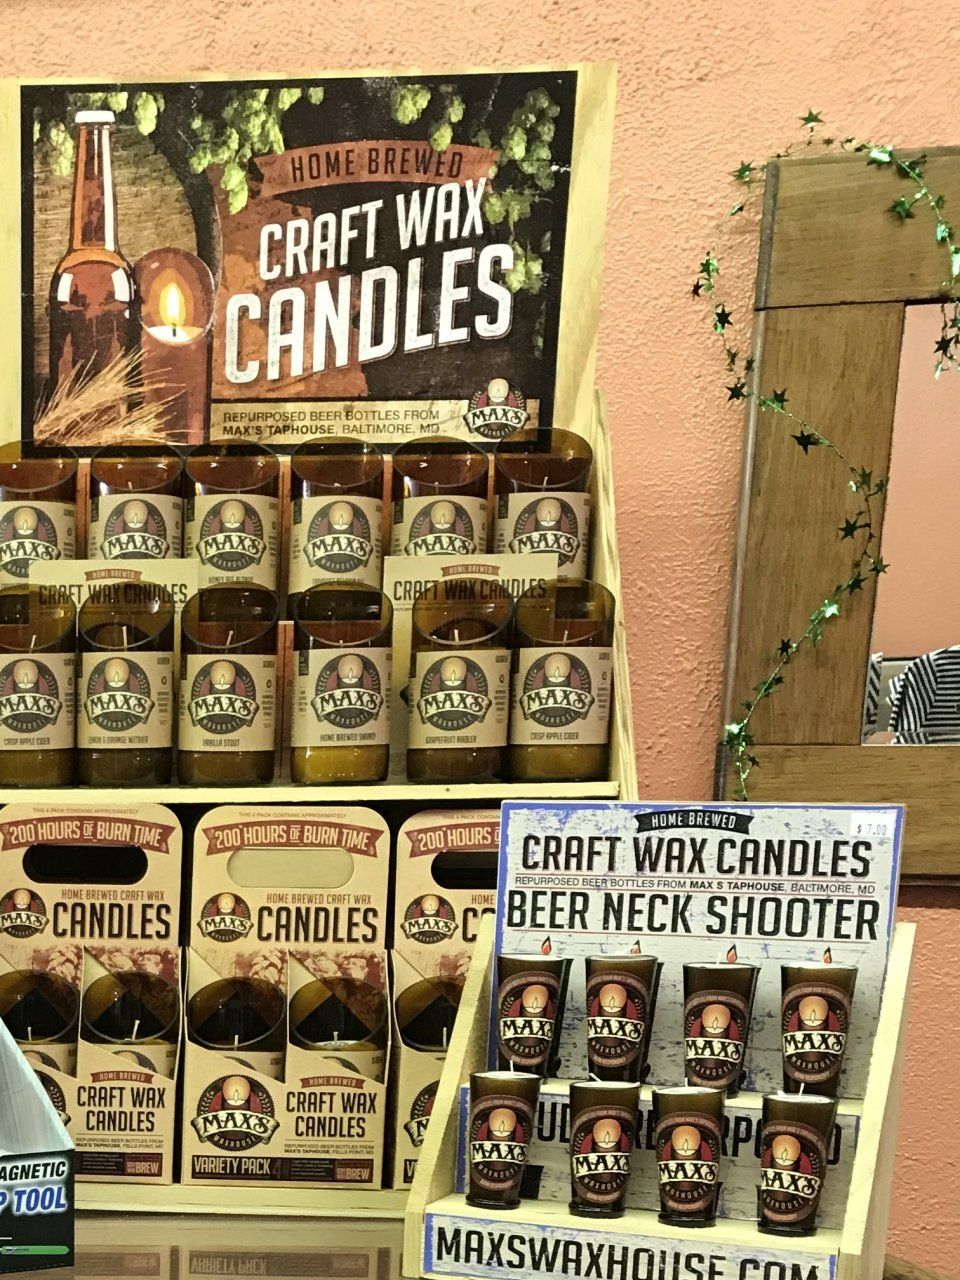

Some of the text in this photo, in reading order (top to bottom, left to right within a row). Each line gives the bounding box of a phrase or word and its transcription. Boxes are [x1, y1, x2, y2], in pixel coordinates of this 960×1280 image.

[291, 147, 464, 183] HOME BREWED
[258, 176, 488, 281] CRAFT WAX
[223, 243, 515, 386] CANDLES
[222, 409, 440, 423] REPURPOSED BEER BOTTLES FROM
[471, 407, 524, 426] MAX'S
[222, 423, 440, 437] MAX'S TAPHOUSE, BALTIMORE, MD
[203, 534, 260, 555] MAX'S
[319, 690, 377, 712] MAX'S
[527, 689, 587, 712] MAX'S
[651, 812, 737, 829] HOME BREWED
[856, 824, 888, 836] $ 7.00
[9, 820, 164, 847] 200 HOURS OF BURN TIME
[214, 824, 372, 851] 200 HOURS OF BURN TIME
[521, 835, 873, 879] CRAFT WAX CANDLES
[62, 889, 165, 902] HOME BREWED CRAFT WAX
[515, 876, 580, 887] REPURPOSED
[581, 877, 609, 887] BEER
[610, 878, 655, 889] BOTTLES
[656, 879, 687, 890] FROM
[727, 881, 788, 892] TAPHOUSE,
[790, 882, 856, 894] BALTIMORE,
[857, 884, 875, 894] MD
[266, 892, 372, 905] HOME BREWED CRAFT WAX
[51, 901, 171, 940] CANDLES
[257, 906, 378, 943] CANDLES
[506, 889, 881, 941] BEER NECK SHOOTER
[783, 1032, 844, 1051] MAX'S
[76, 1085, 166, 1108] CRAFT WAX
[285, 1090, 378, 1115] CRAFT WAX
[85, 1109, 156, 1132] CANDLES
[201, 1112, 271, 1135] MAX'S
[294, 1115, 366, 1138] CANDLES
[135, 1161, 160, 1174] BREW
[193, 1156, 240, 1174] VARIETY
[241, 1157, 271, 1175] PACK
[345, 1167, 371, 1180] BREW
[11, 1186, 67, 1213] TOOL
